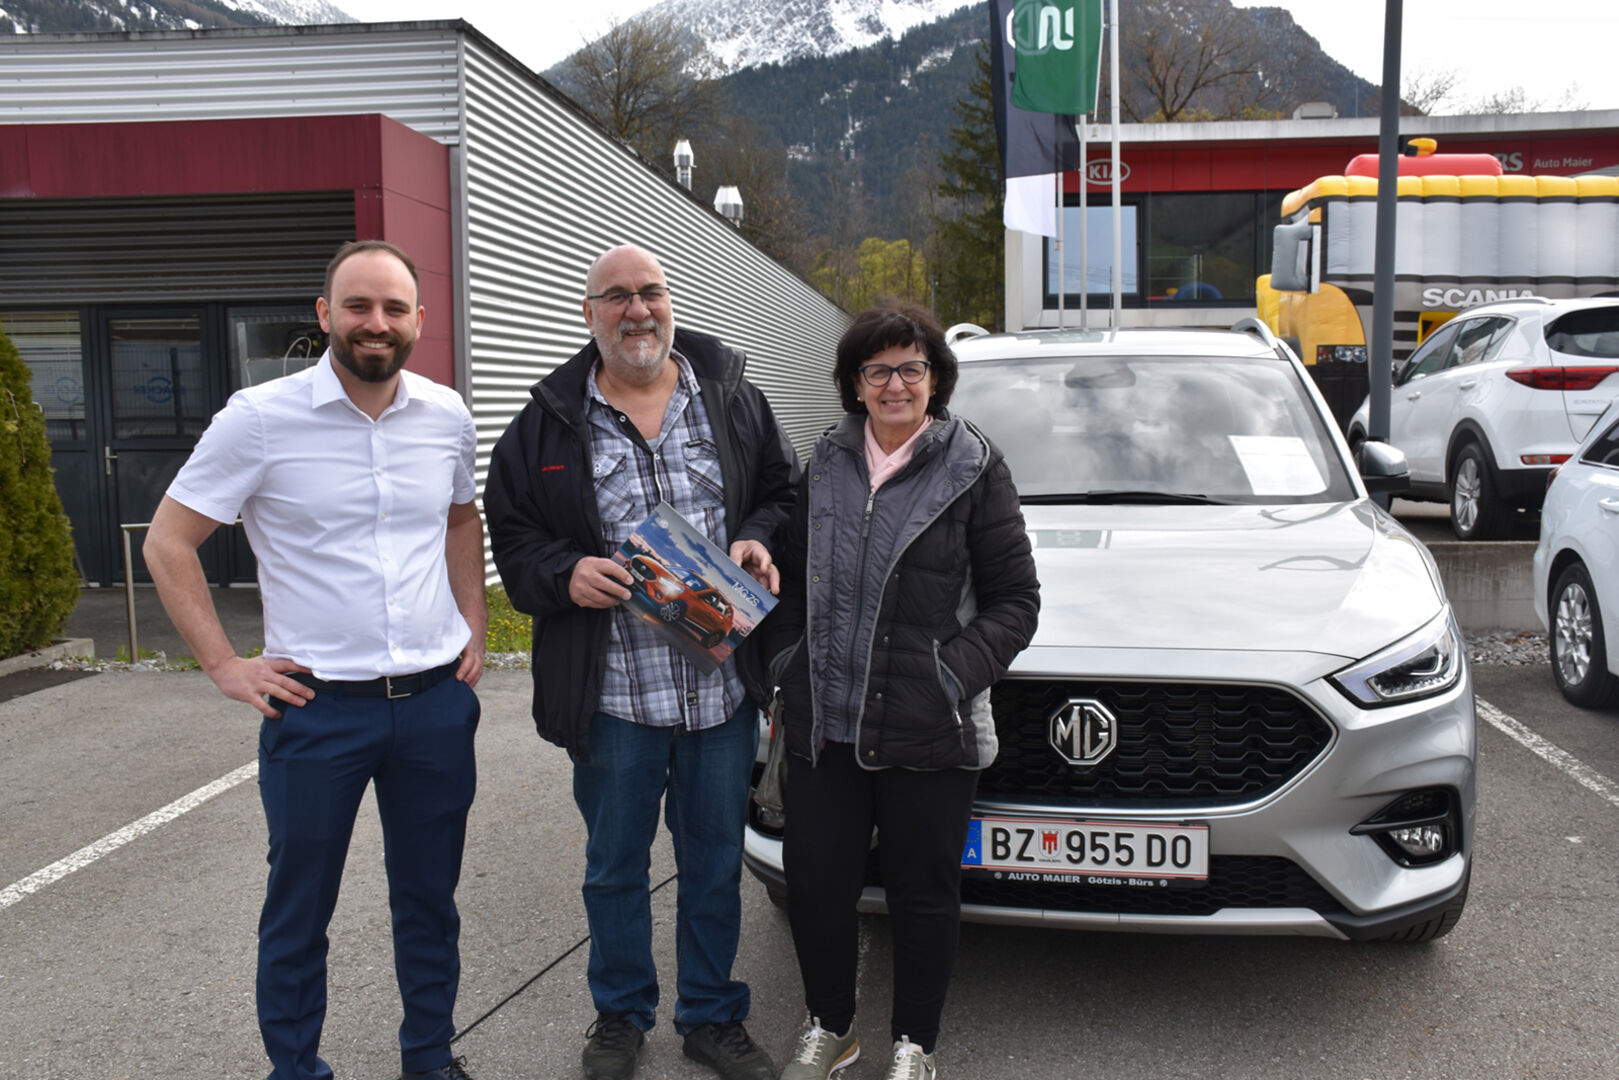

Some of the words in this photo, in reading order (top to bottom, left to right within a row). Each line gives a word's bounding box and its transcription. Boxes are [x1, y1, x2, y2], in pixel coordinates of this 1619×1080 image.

[1534, 159, 1560, 168] Auto
[1562, 158, 1593, 167] Maier
[1089, 165, 1121, 179] KI
[1055, 705, 1108, 759] MG
[991, 827, 1035, 862] BZ
[1066, 830, 1134, 866] 955
[967, 848, 977, 858] A
[1008, 872, 1040, 881] AUTO
[1043, 874, 1080, 883] MAIER
